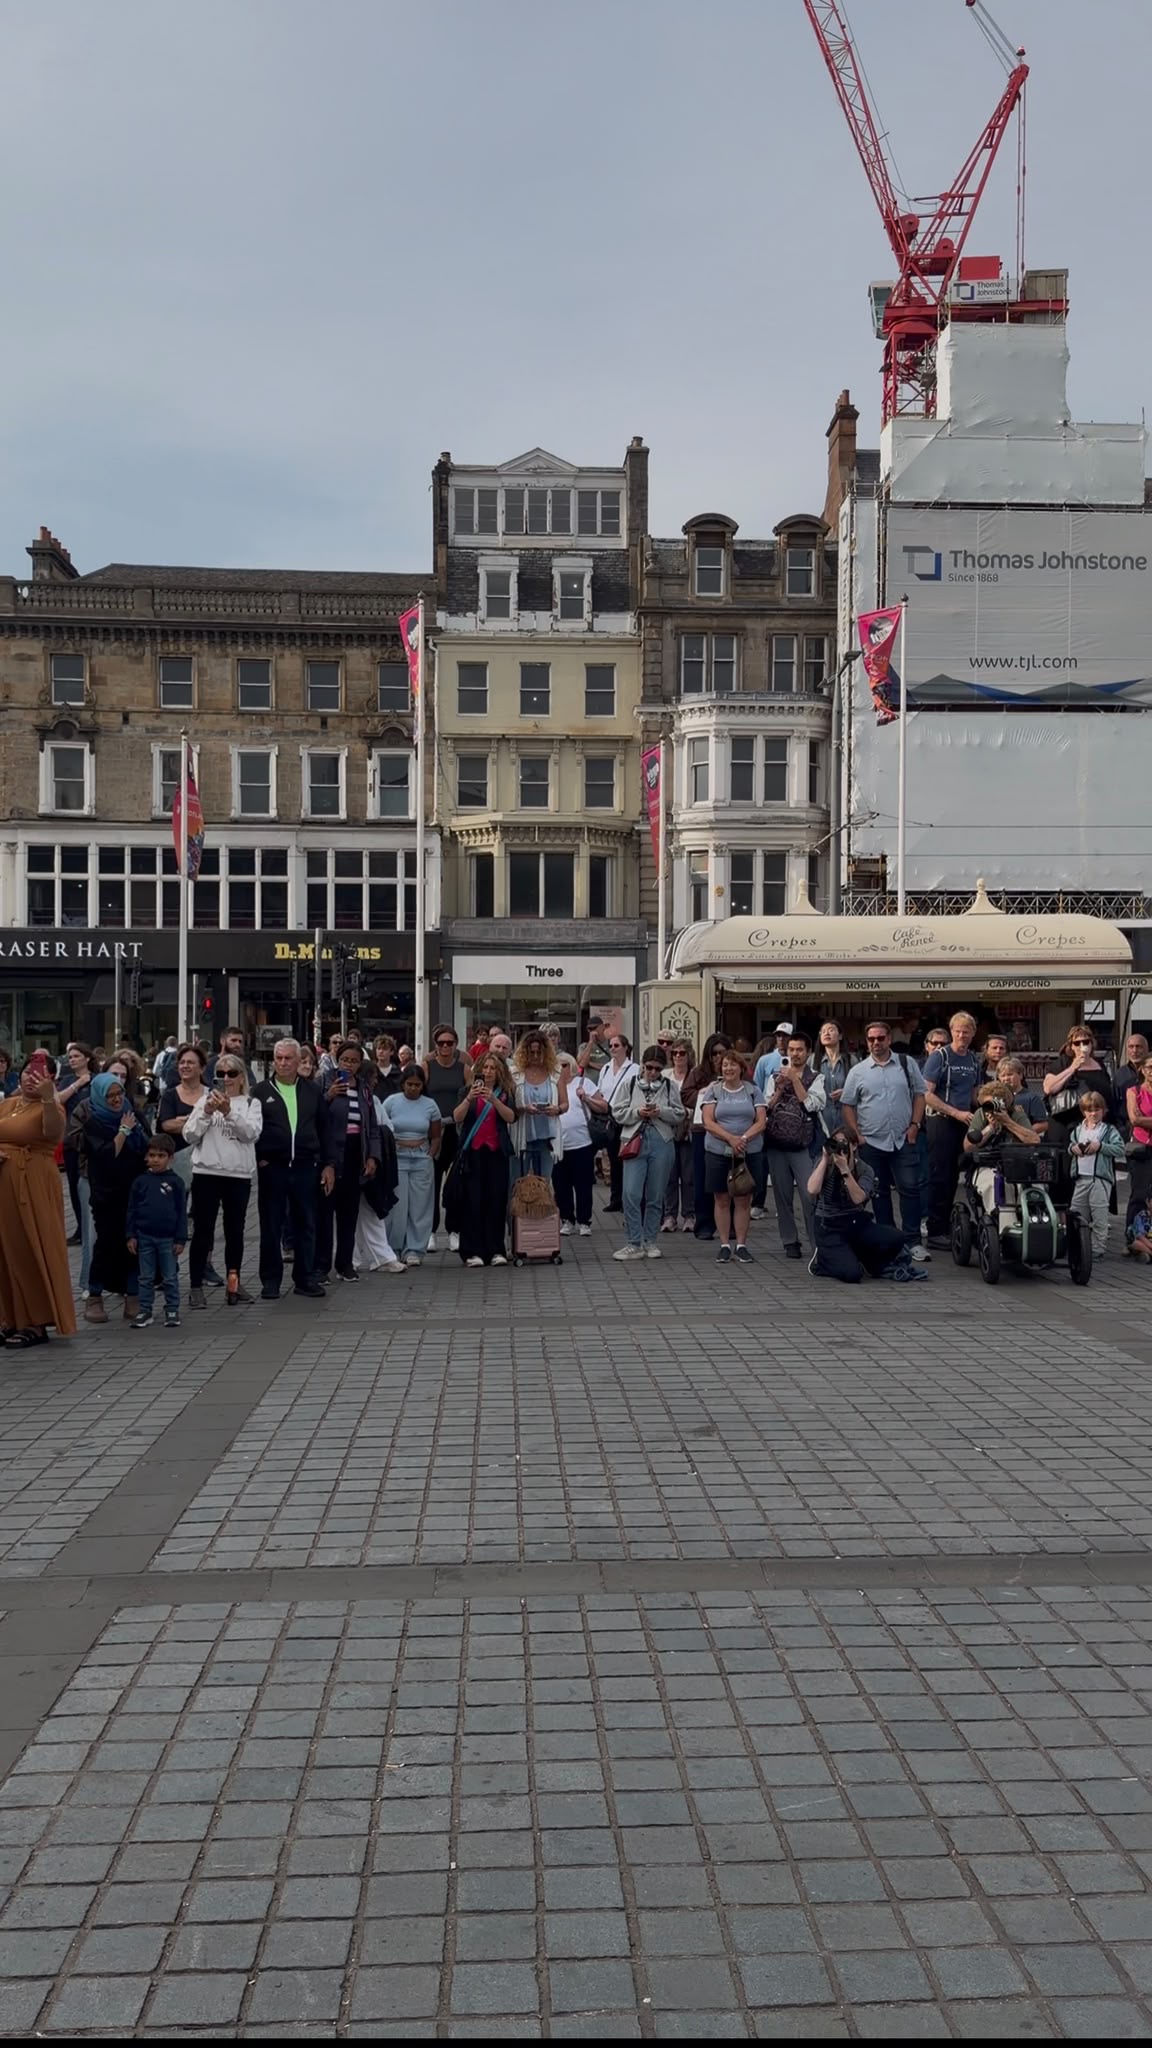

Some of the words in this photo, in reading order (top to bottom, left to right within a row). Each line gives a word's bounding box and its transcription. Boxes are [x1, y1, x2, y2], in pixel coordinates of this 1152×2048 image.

[949, 550, 1034, 569] Thomas
[1038, 551, 1147, 570] Johnstone
[948, 573, 974, 582] Since
[977, 573, 998, 582] 1868
[969, 654, 1078, 671] www.tjl.com
[748, 929, 817, 949] Crepes
[1016, 925, 1086, 949] Crepes
[77, 942, 143, 957] HART
[525, 965, 564, 977] Three
[846, 982, 880, 990] MOCHA
[920, 981, 949, 989] LATTE
[989, 980, 1051, 988] CAPPUCCINO
[1091, 978, 1148, 986] AMERICANO
[668, 1019, 692, 1030] ICE
